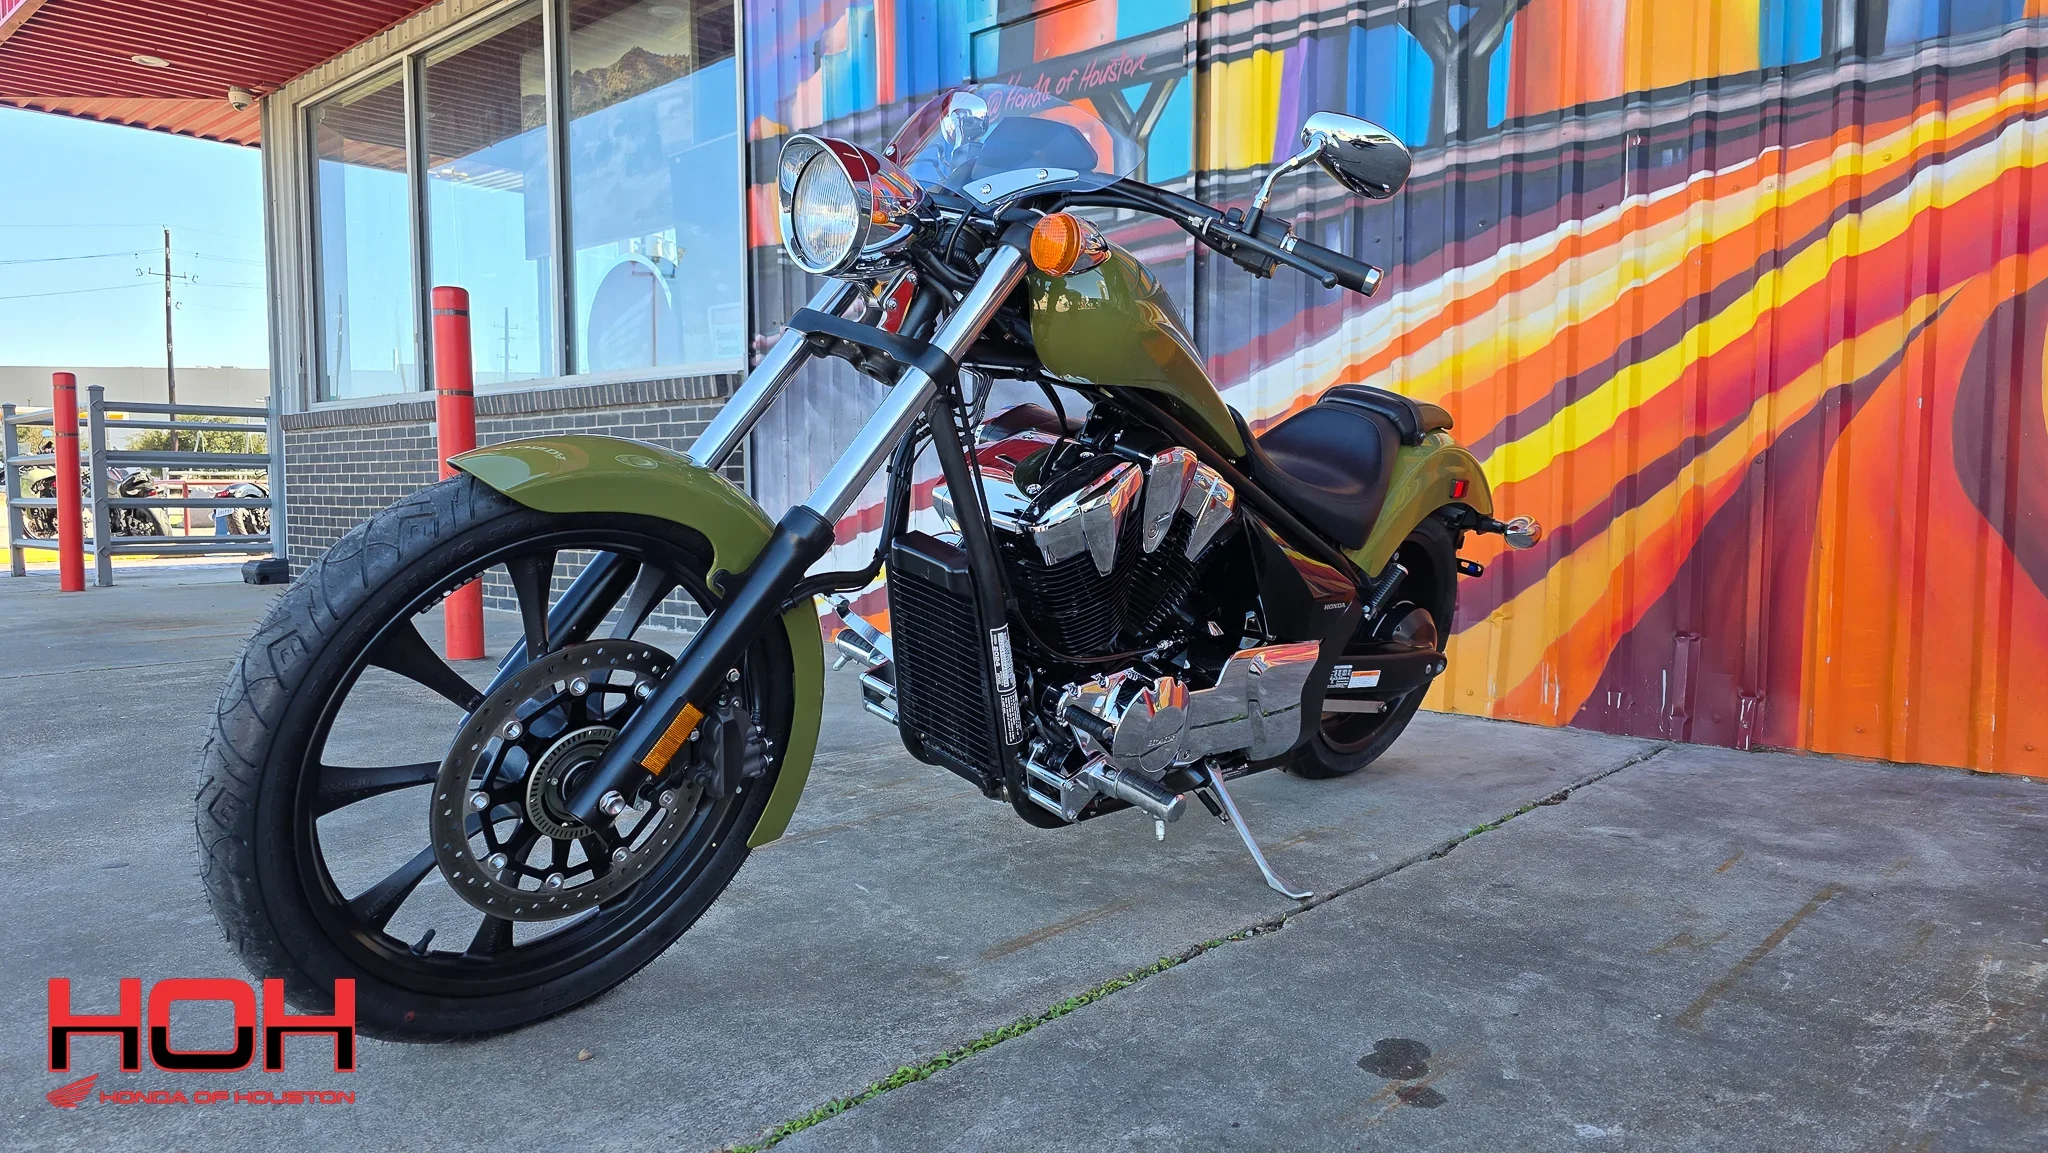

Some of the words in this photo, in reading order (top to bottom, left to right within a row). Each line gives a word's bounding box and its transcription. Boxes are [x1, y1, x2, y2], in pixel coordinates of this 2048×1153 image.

[1004, 72, 1052, 110] Honda
[1055, 68, 1079, 96] of
[1078, 50, 1148, 92] Houston
[1323, 602, 1347, 611] HONDA
